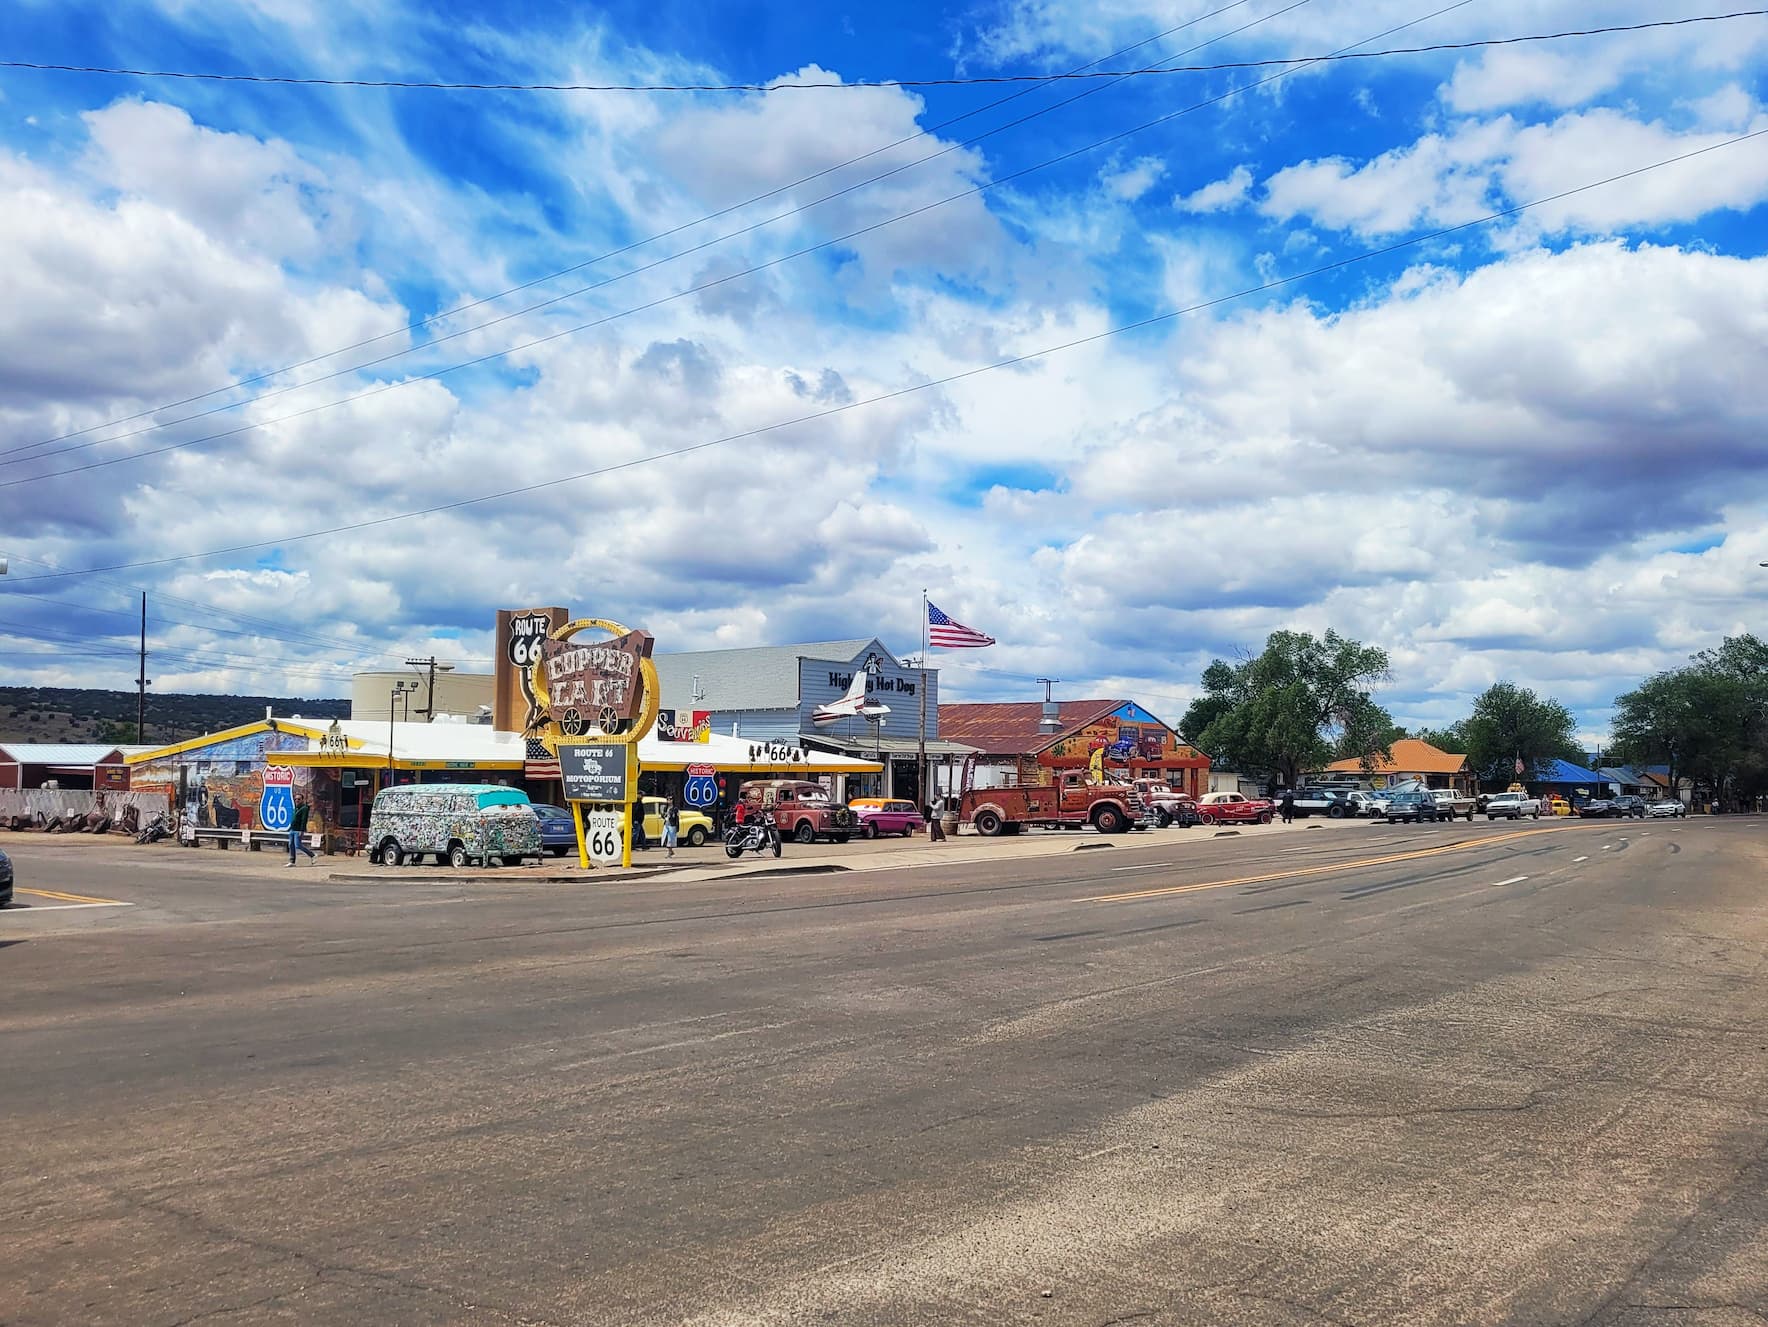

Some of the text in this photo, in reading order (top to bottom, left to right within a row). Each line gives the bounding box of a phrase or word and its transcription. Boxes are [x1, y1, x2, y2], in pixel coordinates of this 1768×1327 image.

[515, 617, 546, 636] ROUTE
[513, 636, 543, 664] 66
[546, 647, 634, 680] COPPER
[552, 677, 630, 707] CART
[829, 671, 915, 695] Highy Hot Dog
[329, 735, 340, 747] 66
[574, 749, 613, 757] ROUTE 66
[771, 746, 786, 761] 66
[265, 771, 291, 781] HISTORIC
[566, 775, 622, 783] MOTOPORIUM
[690, 780, 713, 802] 66
[267, 795, 288, 825] 66
[592, 817, 615, 828] ROUTE
[592, 831, 614, 856] 66
